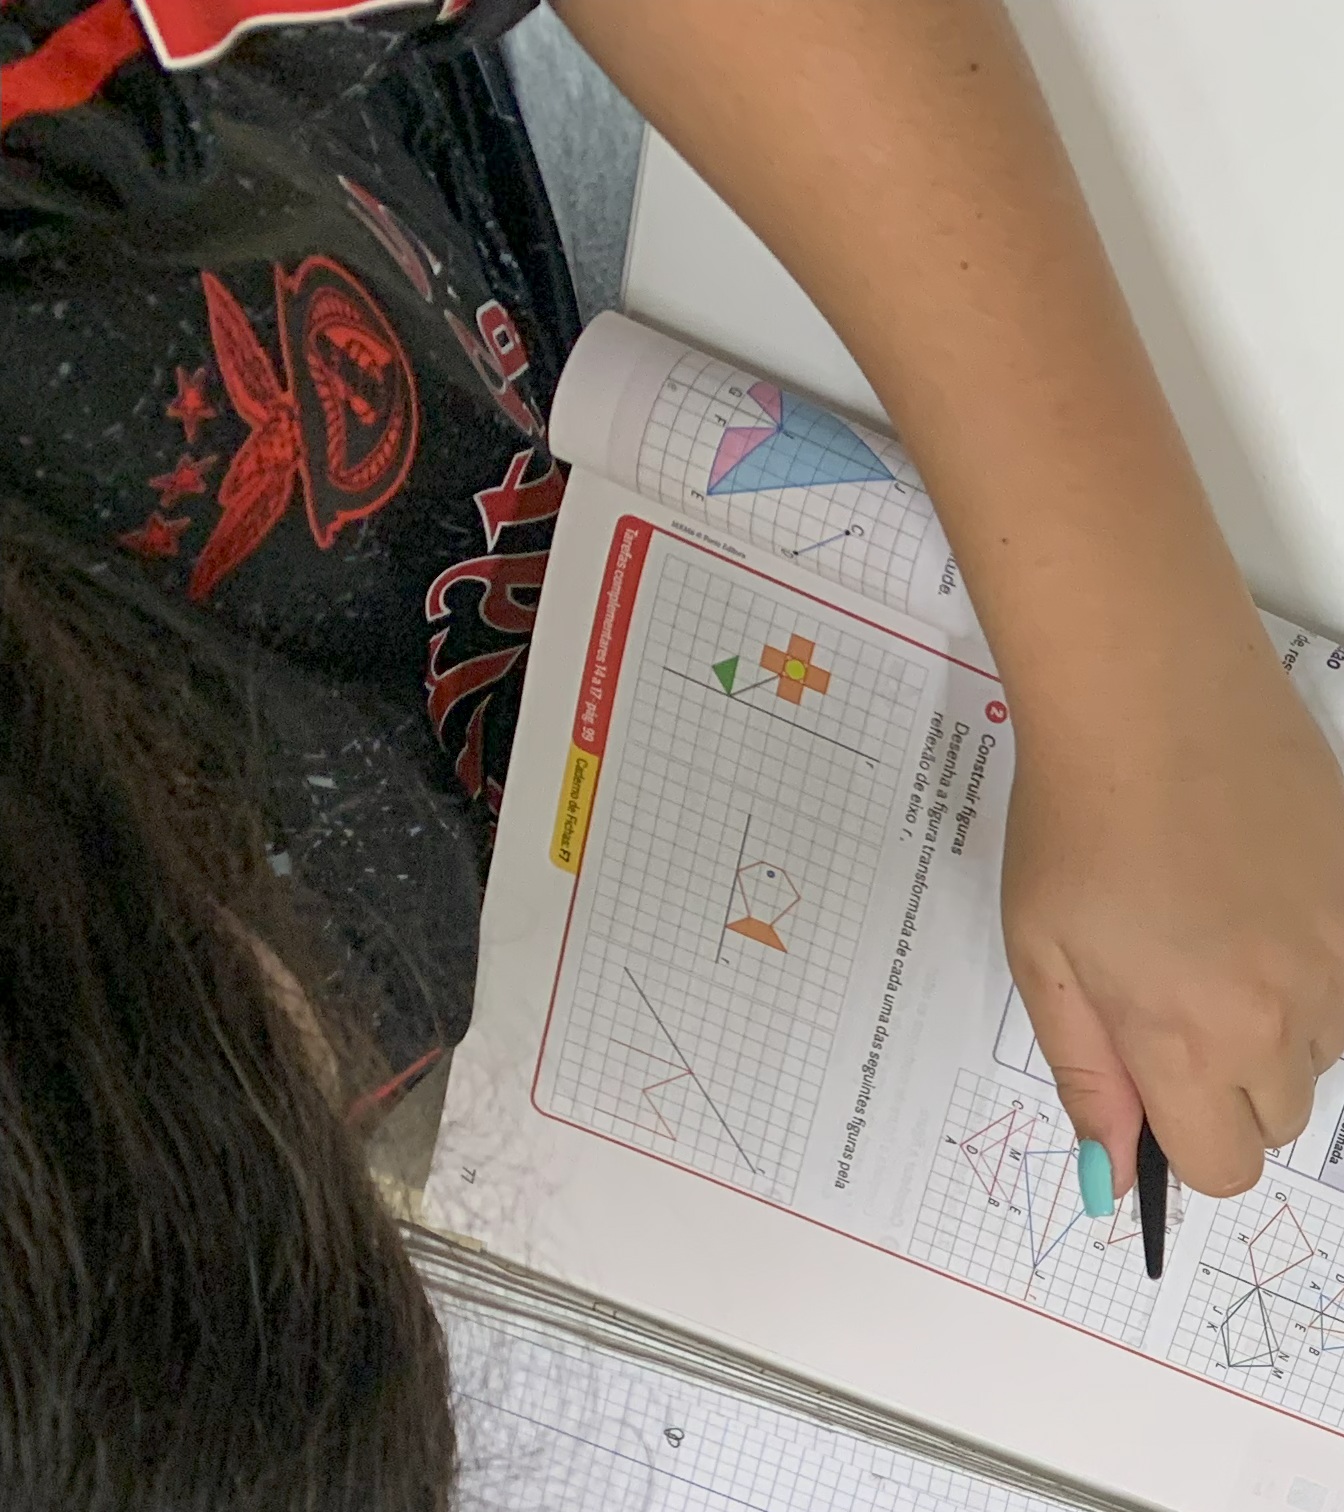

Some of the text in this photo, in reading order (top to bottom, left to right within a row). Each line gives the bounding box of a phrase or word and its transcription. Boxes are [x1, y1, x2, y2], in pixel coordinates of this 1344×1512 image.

[595, 527, 639, 663] Tarefas complementares
[912, 772, 930, 791] de
[918, 710, 944, 770] reflexão
[558, 757, 588, 863] Caderno de Fichas: F7
[905, 793, 923, 823] eixo
[950, 733, 996, 855] Construir figuras
[834, 721, 970, 1189] Desenha a figura transformada de cada uma das seguintes figuras pela
[460, 1165, 476, 1184] 77
